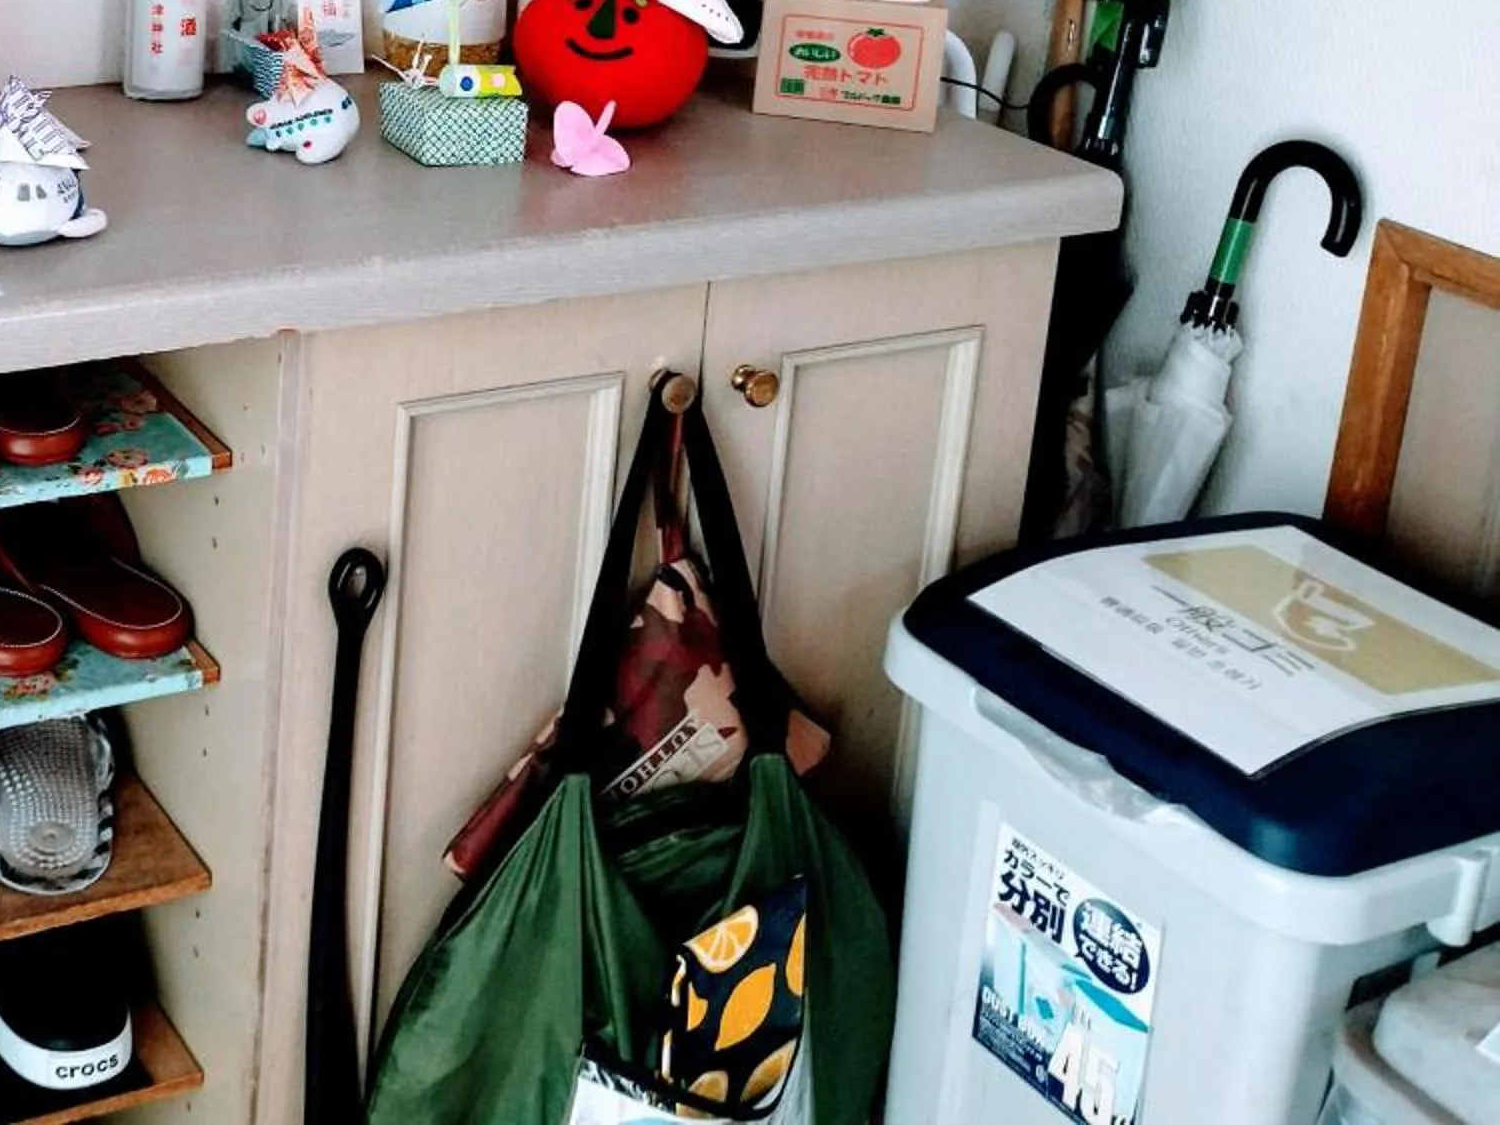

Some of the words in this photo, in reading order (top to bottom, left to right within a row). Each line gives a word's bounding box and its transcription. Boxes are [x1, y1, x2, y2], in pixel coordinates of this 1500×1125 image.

[1151, 584, 1315, 677] 一般ゴミ
[997, 869, 1066, 945] 分別
[1003, 849, 1071, 908] カラーで
[1079, 932, 1138, 992] できる!
[55, 1054, 119, 1079] crocs
